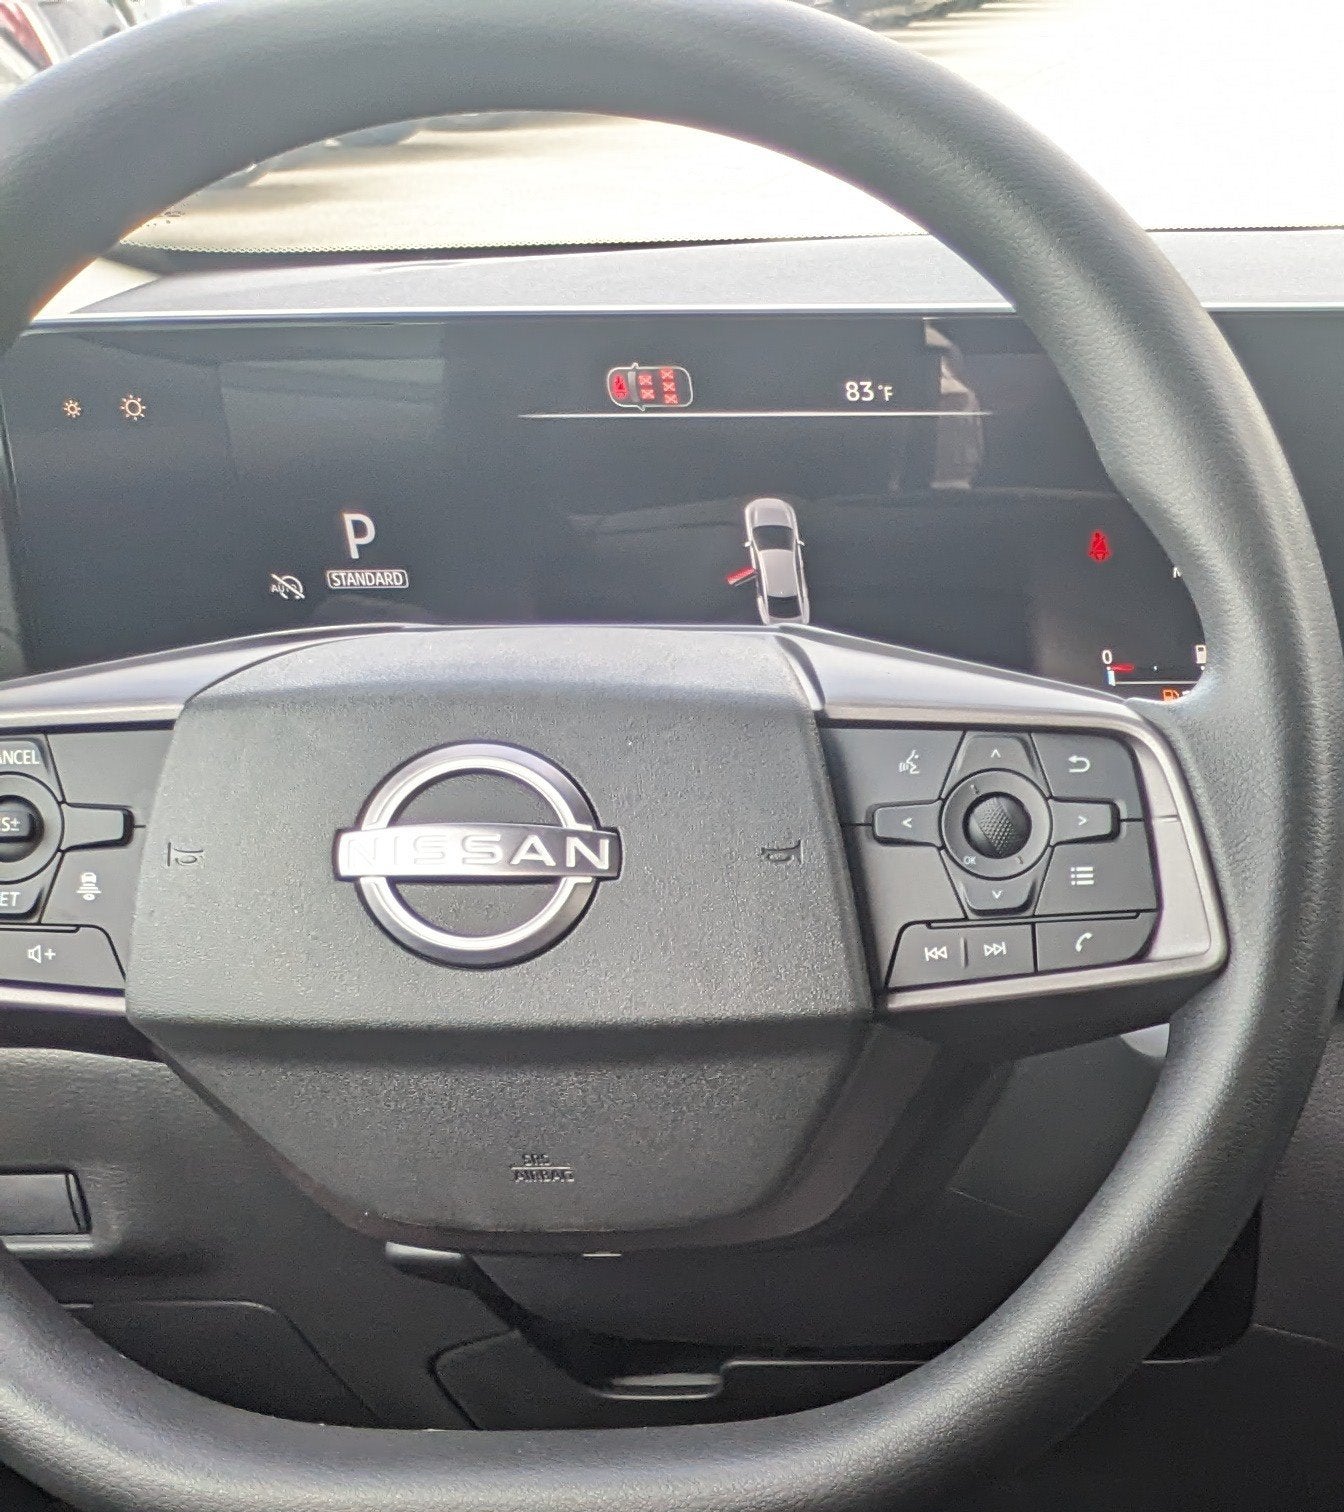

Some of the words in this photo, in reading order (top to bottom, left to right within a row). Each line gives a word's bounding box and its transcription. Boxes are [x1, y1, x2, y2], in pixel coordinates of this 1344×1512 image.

[342, 513, 376, 559] P
[331, 573, 402, 586] STANDARD
[349, 834, 609, 870] NISSAN
